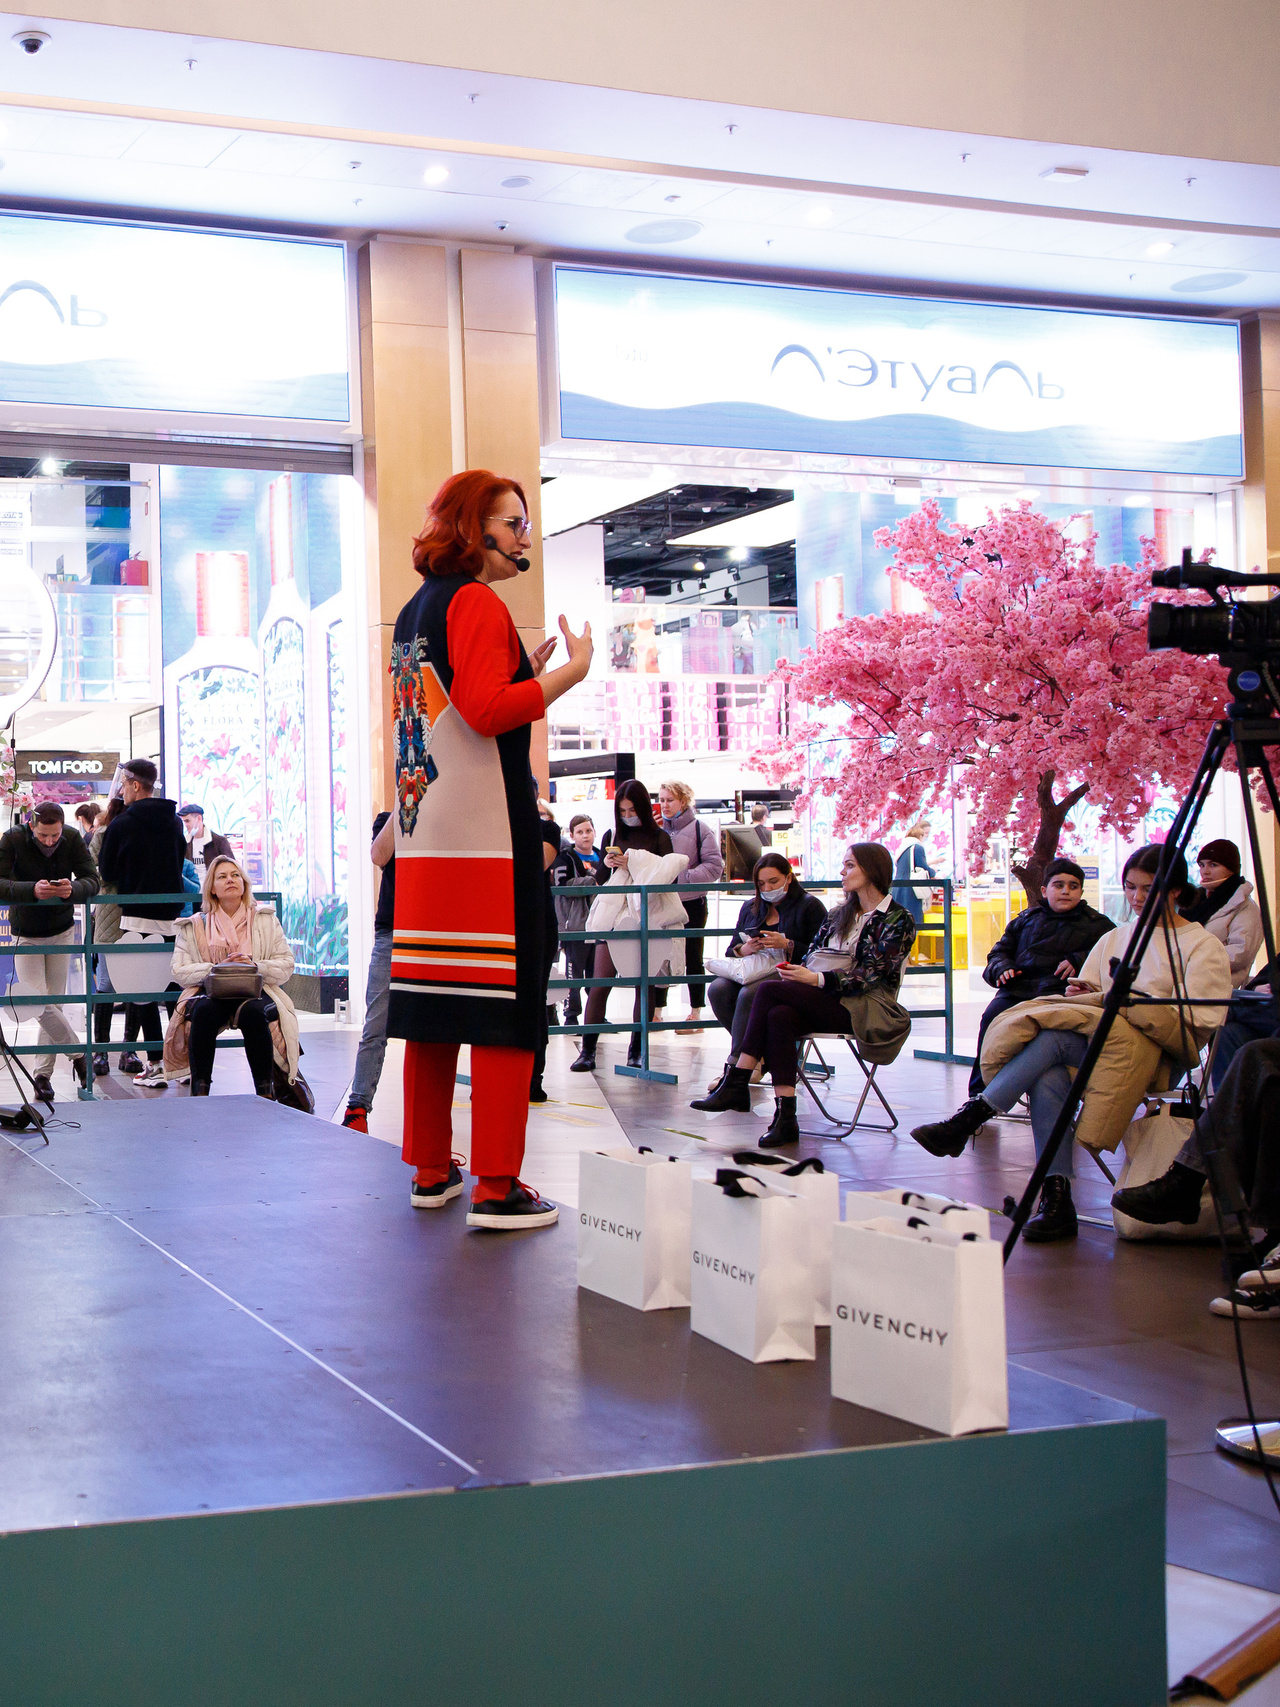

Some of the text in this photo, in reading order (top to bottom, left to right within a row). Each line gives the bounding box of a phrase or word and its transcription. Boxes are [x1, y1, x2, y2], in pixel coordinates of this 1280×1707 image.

[28, 760, 103, 774] TOM FORD
[579, 1212, 642, 1243] GIVENCHY
[692, 1250, 756, 1286] GIVENCHY
[836, 1304, 949, 1347] GIVENCHY
